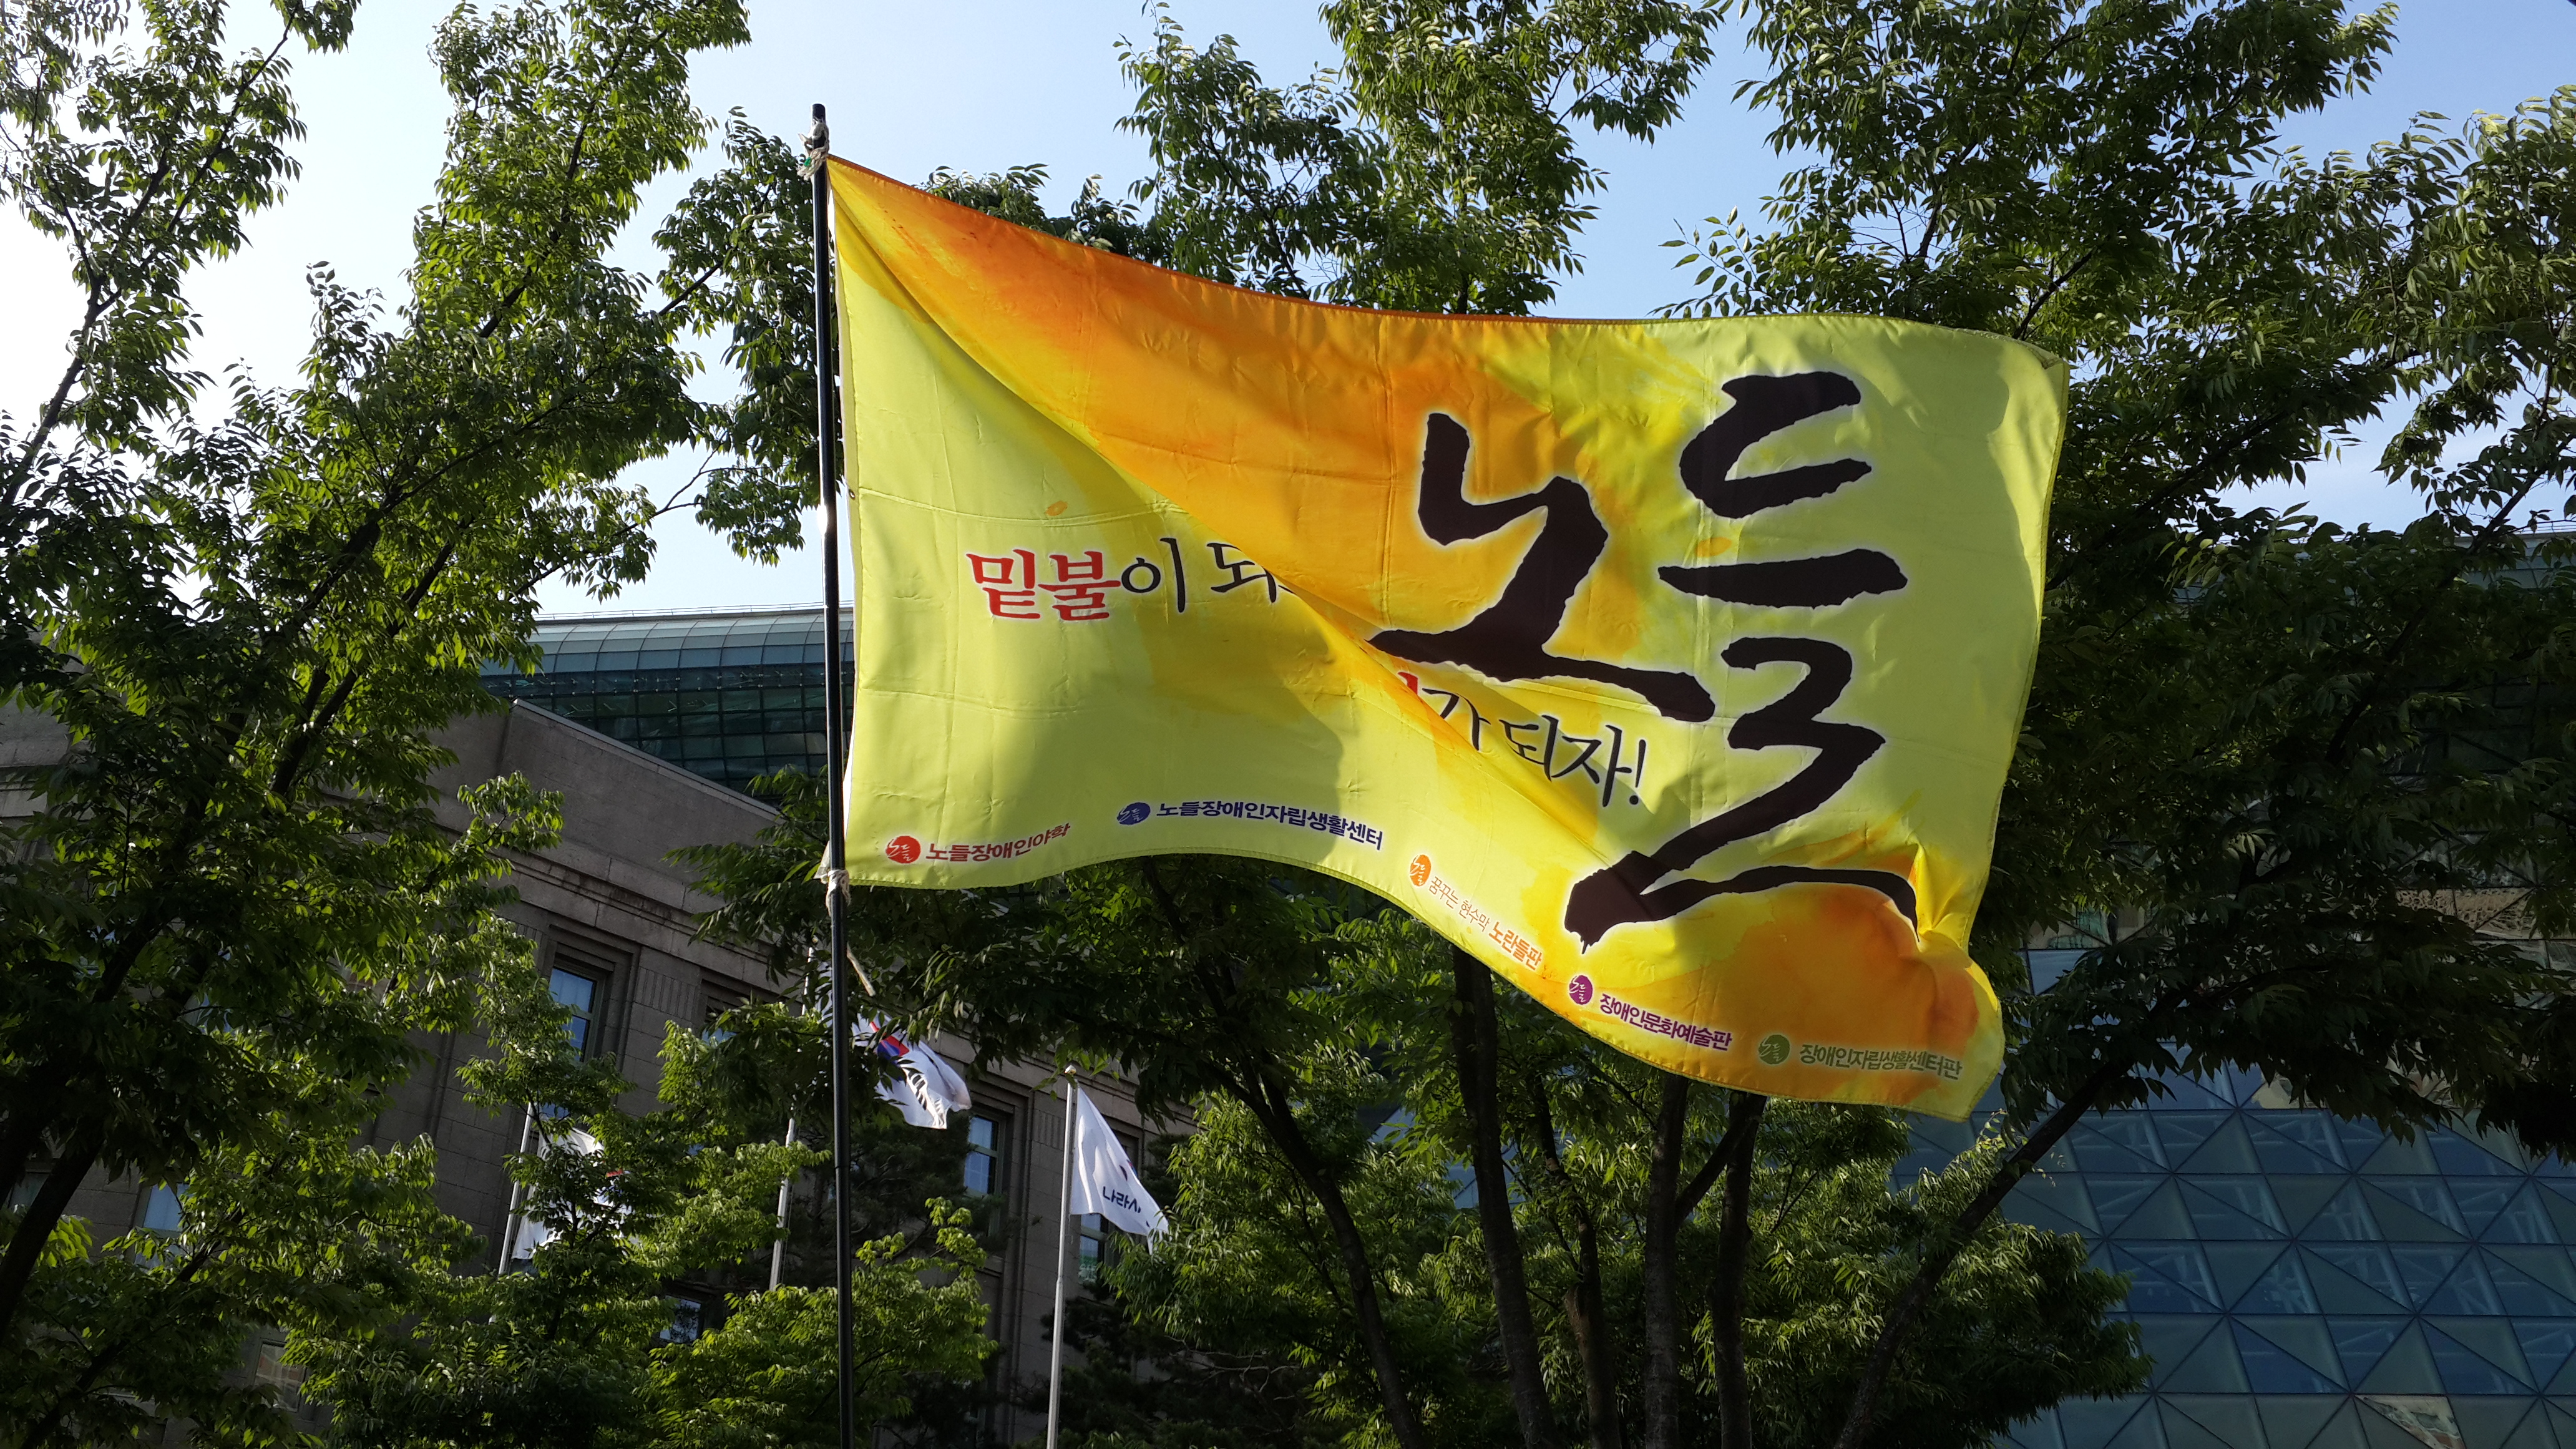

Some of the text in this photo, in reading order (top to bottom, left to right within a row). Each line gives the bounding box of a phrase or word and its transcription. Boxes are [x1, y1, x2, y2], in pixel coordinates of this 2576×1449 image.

[967, 536, 1647, 807] 밑불이 되 가 되자!
[1367, 371, 1919, 954] 노들
[925, 823, 1071, 862] 노들장애인야학
[1156, 801, 1383, 851] 노들장애인자립생활센터
[1428, 876, 1458, 909] 꿈꾸는
[1458, 900, 1490, 932] 현수막
[1488, 921, 1543, 971] 노란들판
[1599, 993, 1732, 1051] 장애인문화예술판
[1800, 1043, 1963, 1081] 장애인자립생활센터판
